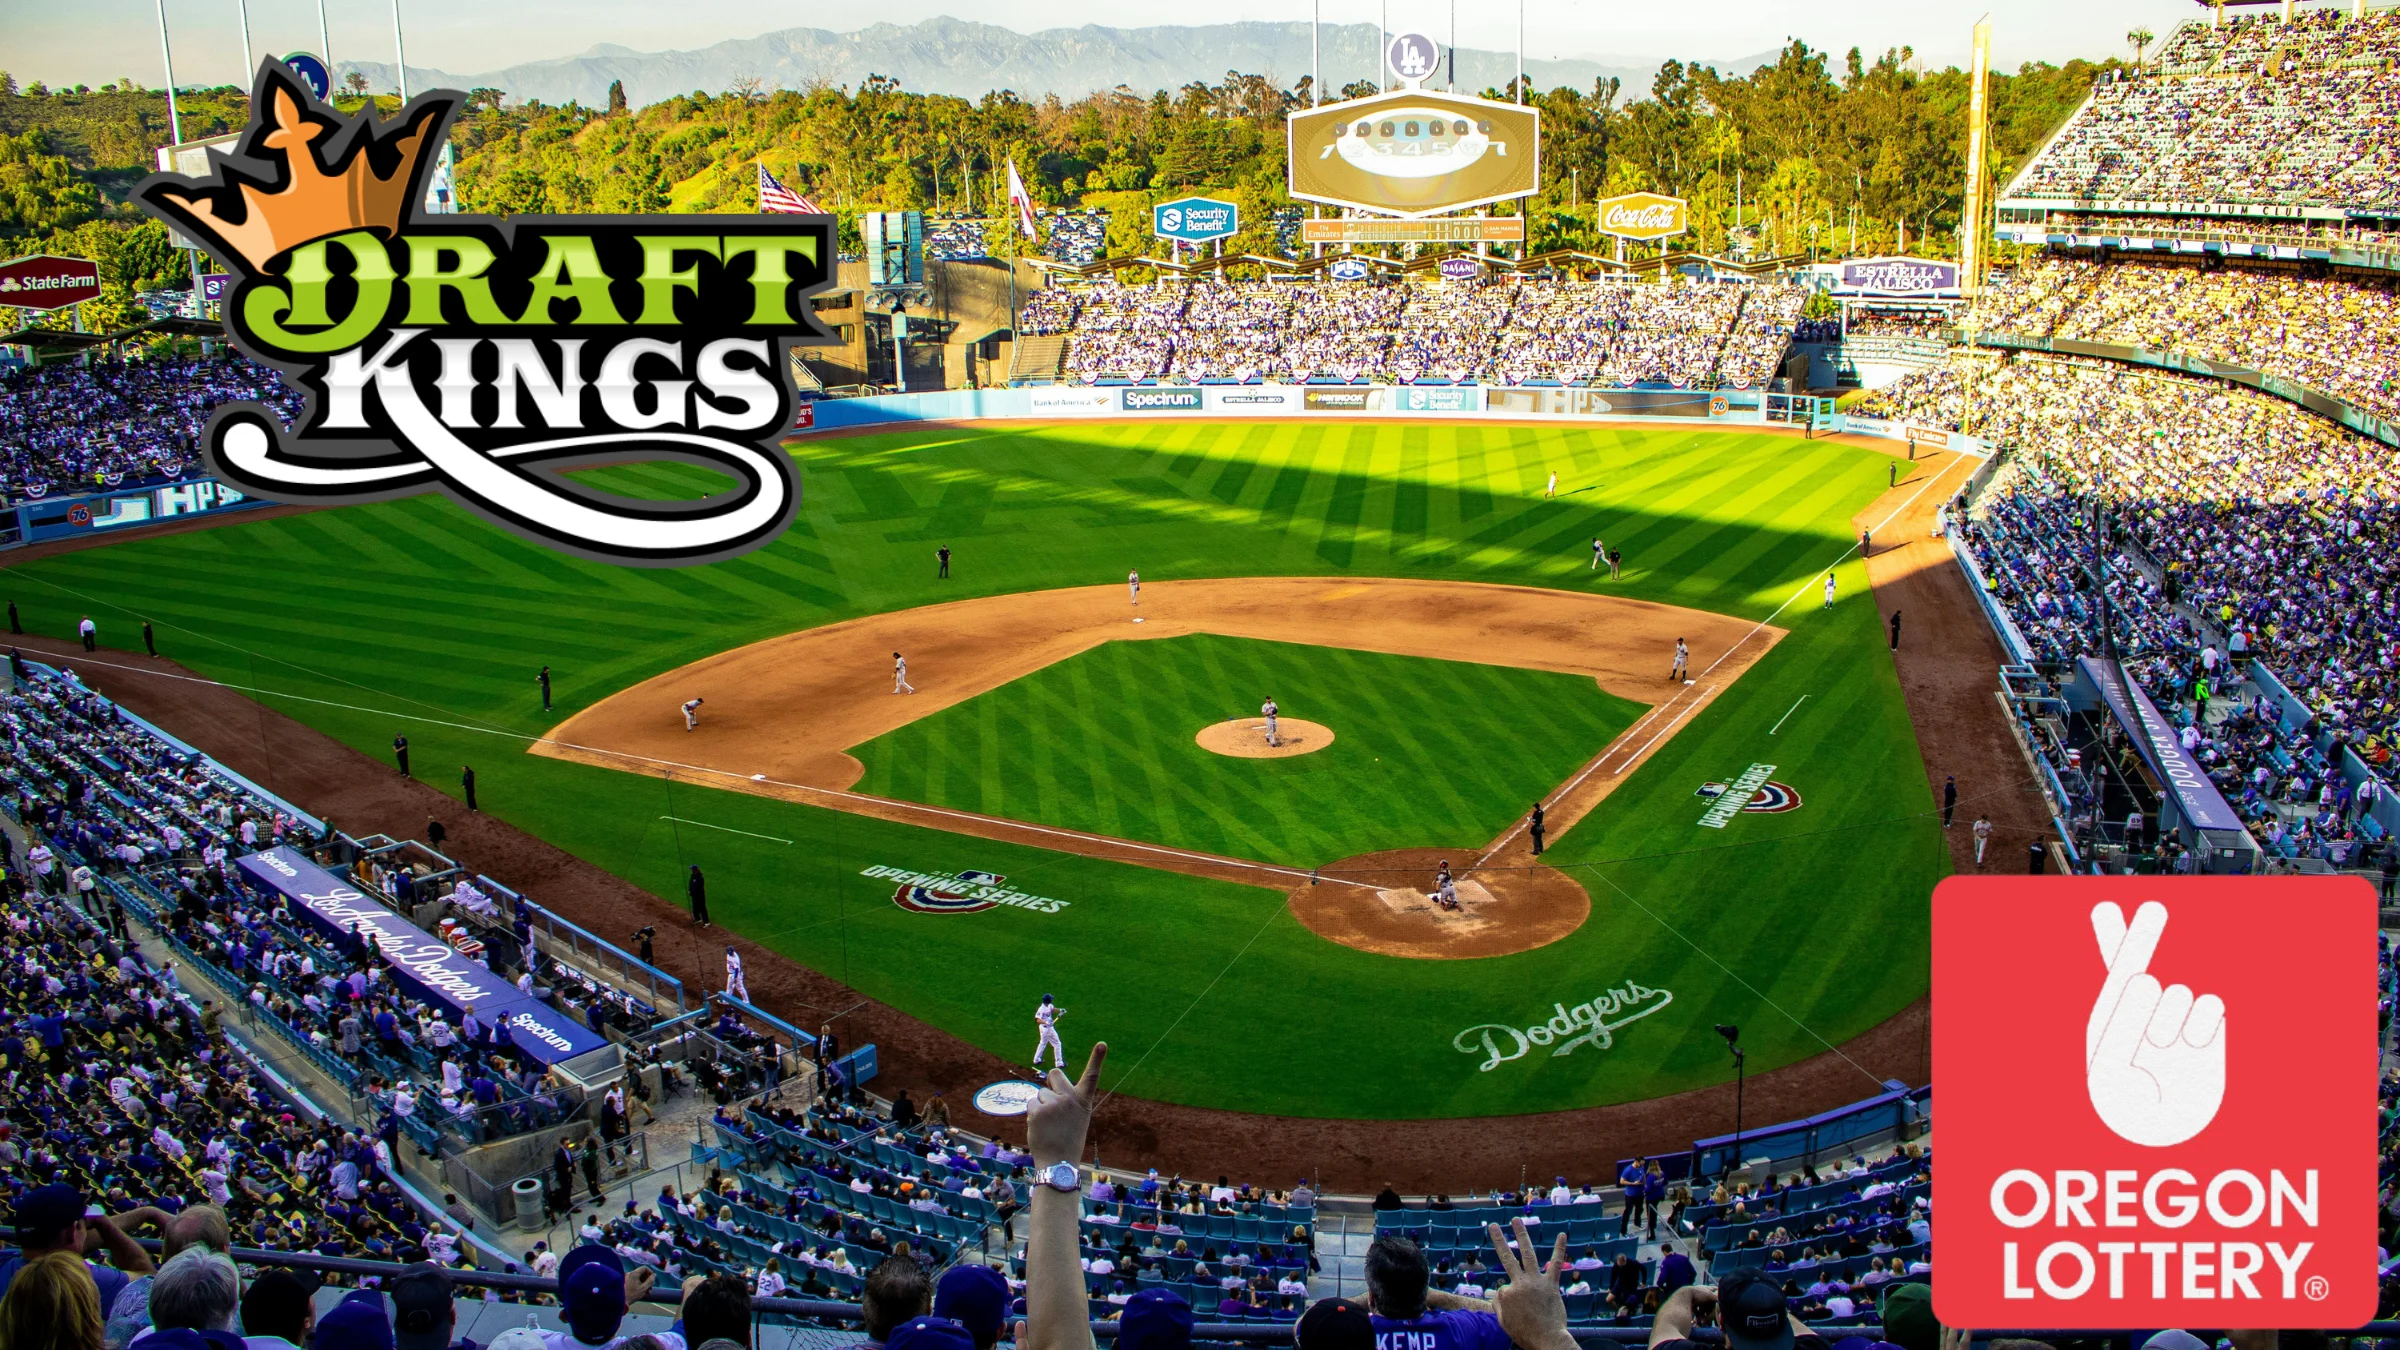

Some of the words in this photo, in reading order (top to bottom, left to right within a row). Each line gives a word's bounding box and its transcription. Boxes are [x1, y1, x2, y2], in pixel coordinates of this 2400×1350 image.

[1400, 37, 1426, 75] LA
[1185, 207, 1230, 222] Security
[2074, 200, 2151, 211] DODGER
[2165, 203, 2249, 215] STADIUM
[2262, 206, 2304, 217] CLUB
[1186, 219, 1225, 231] Benefit
[1308, 230, 1341, 238] Emirates
[1442, 262, 1476, 274] DASANI
[1854, 265, 1944, 279] ESTRELLA
[22, 275, 60, 291] State
[60, 273, 95, 288] Farm
[1862, 277, 1935, 290] JALISCO
[1034, 399, 1053, 407] Bank
[1126, 391, 1194, 409] Spectrum
[1711, 401, 1726, 412] 76
[1846, 421, 1858, 429] Bank
[1862, 423, 1881, 432] America
[71, 510, 88, 522] 76
[2150, 735, 2203, 788] DODGER
[1697, 789, 1753, 829] OPENING
[1732, 762, 1778, 792] SERIES
[256, 851, 298, 877] Spectrum
[859, 864, 976, 894] OPENING
[969, 886, 1071, 914] SERIES
[300, 888, 364, 915] Los
[396, 945, 492, 1001] Dodgers
[511, 1012, 572, 1052] Spectrum
[1453, 979, 1673, 1072] Dodgers
[1375, 1331, 1436, 1350] KEMP
